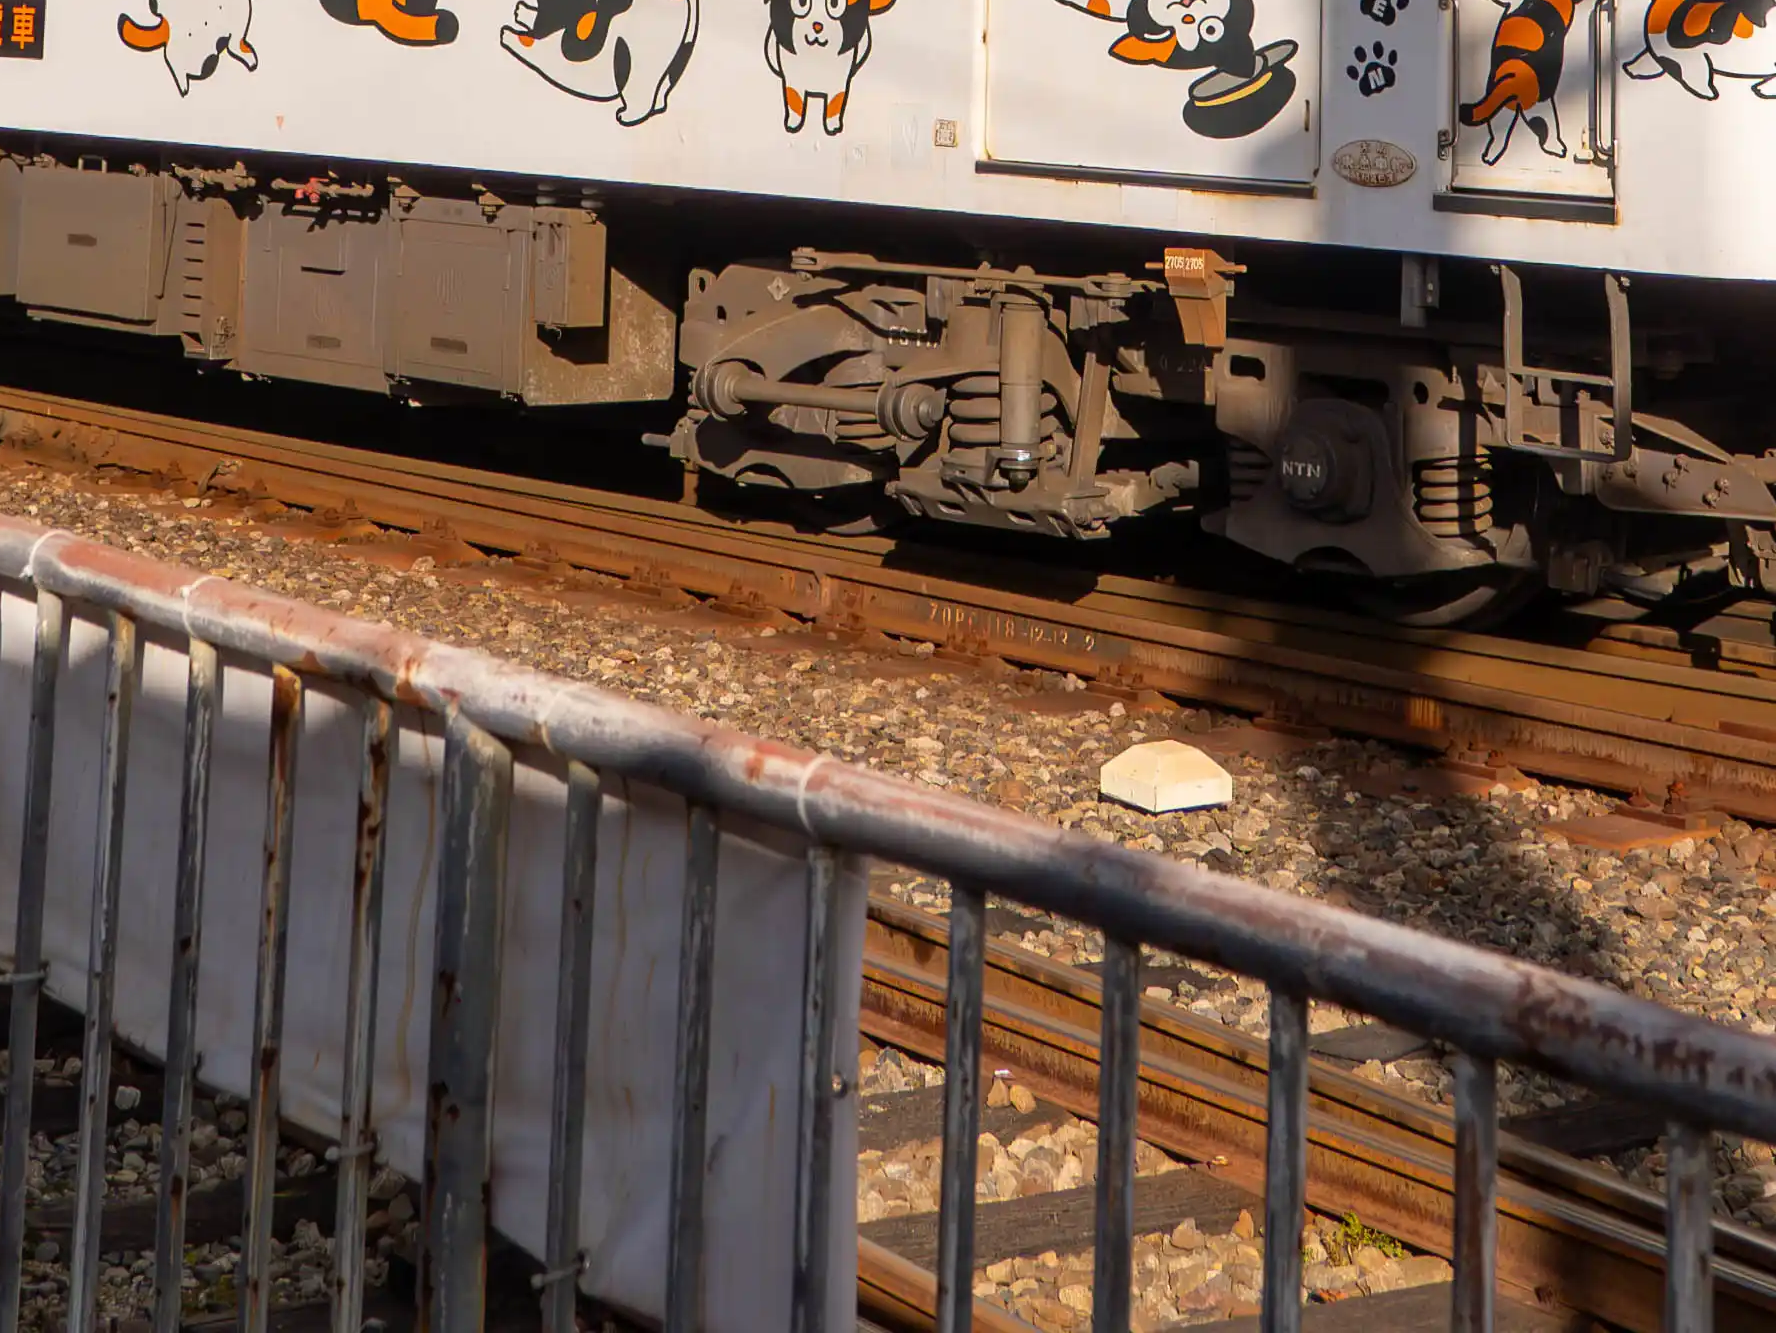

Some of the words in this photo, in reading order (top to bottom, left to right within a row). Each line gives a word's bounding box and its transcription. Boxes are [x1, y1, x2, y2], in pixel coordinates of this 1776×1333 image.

[1165, 254, 1184, 270] 2705
[1185, 256, 1204, 271] 2705
[1282, 461, 1322, 479] NTN
